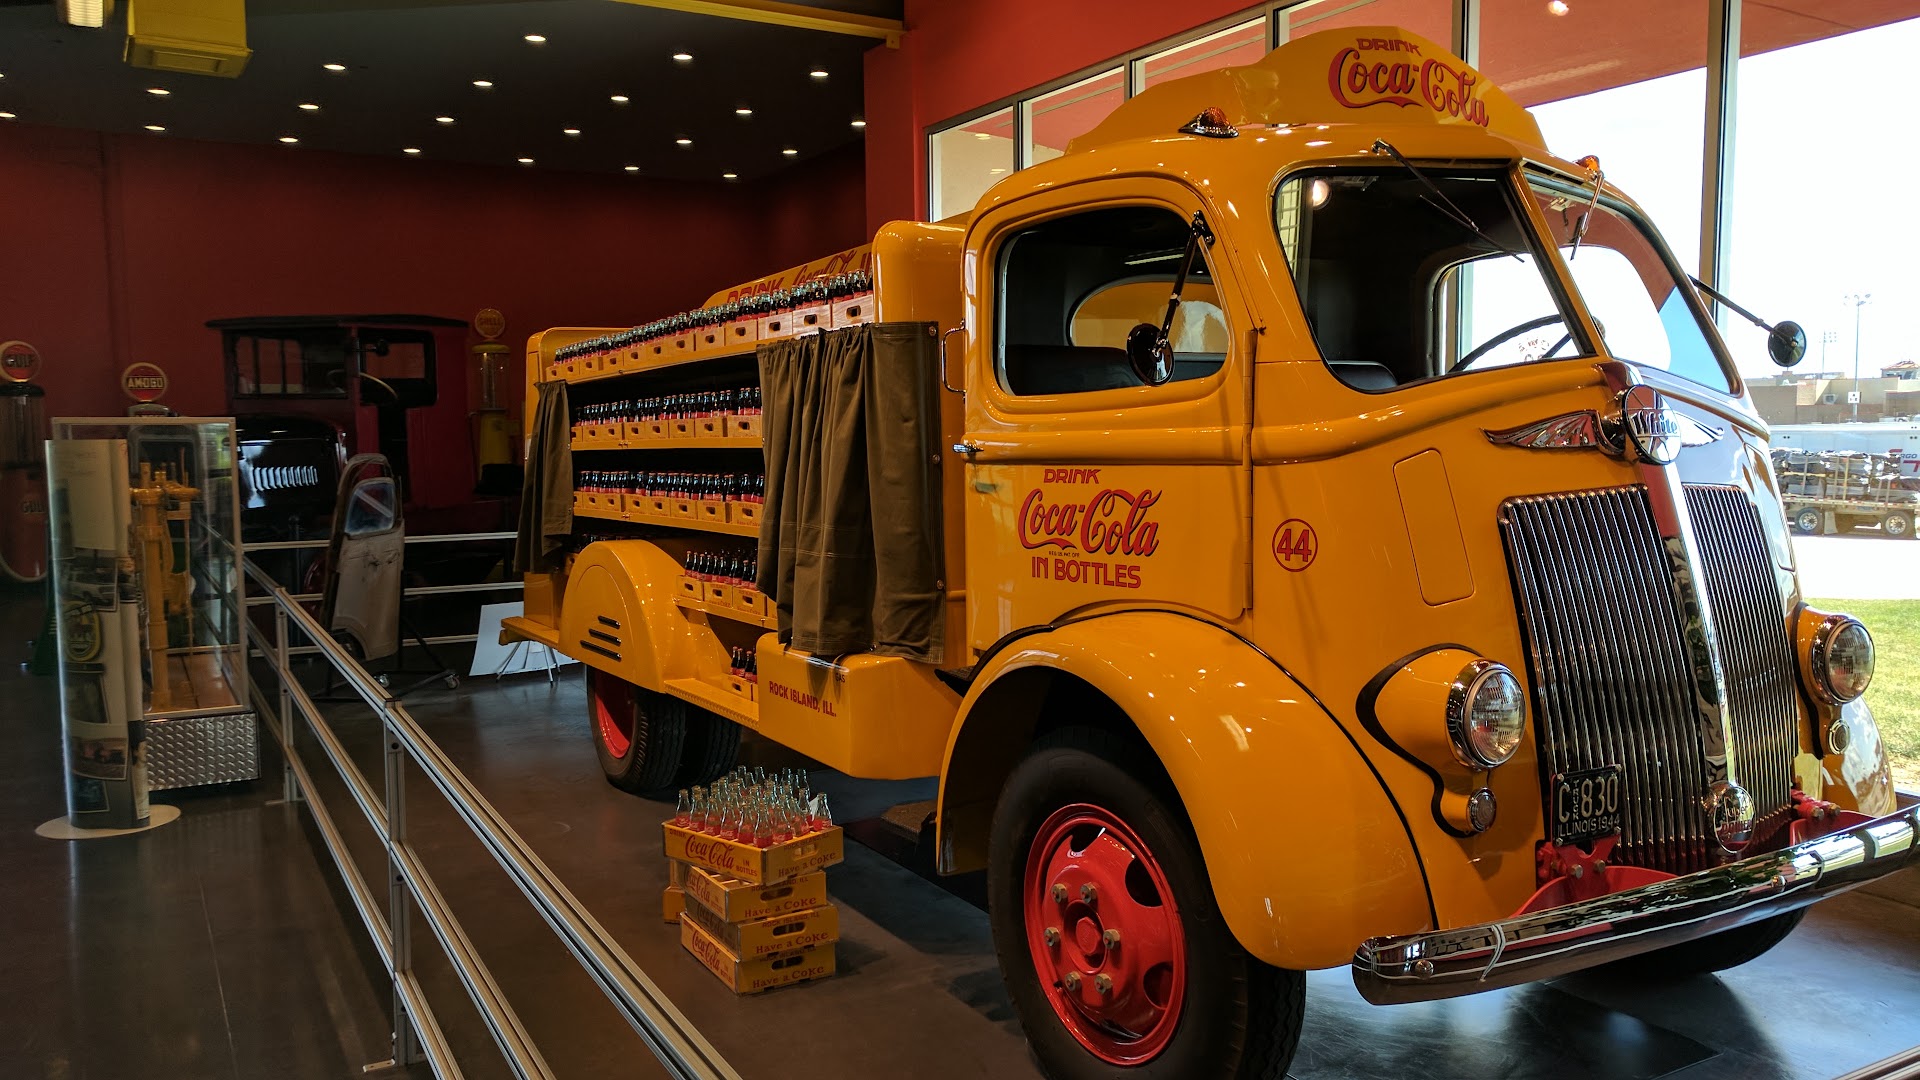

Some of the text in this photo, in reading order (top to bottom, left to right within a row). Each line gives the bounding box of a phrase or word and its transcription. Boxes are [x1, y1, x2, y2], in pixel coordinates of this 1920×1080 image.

[1356, 38, 1422, 56] DRINK
[1328, 47, 1489, 128] Coca-Cola
[1630, 410, 1678, 435] White
[1043, 468, 1102, 484] DRINK
[1018, 488, 1163, 557] Coca-Cola
[1276, 528, 1312, 562] 44
[1031, 556, 1142, 589] IN BOTTLES
[835, 672, 846, 683] GAS
[769, 680, 837, 717] ROCK ISLAND, ILL.
[1558, 774, 1619, 823] C 830
[1572, 779, 1580, 820] TRUCK
[1557, 813, 1620, 837] ILLINOIS 1944
[685, 834, 734, 870] Coca-Cola
[778, 866, 800, 877] Have
[809, 851, 836, 866] Coke
[735, 865, 758, 876] BOTTLES
[744, 907, 771, 918] Have
[783, 897, 816, 910] Coke
[756, 943, 783, 954] Have
[795, 932, 829, 945] Coke
[752, 977, 778, 988] Have
[791, 966, 824, 979] Coke
